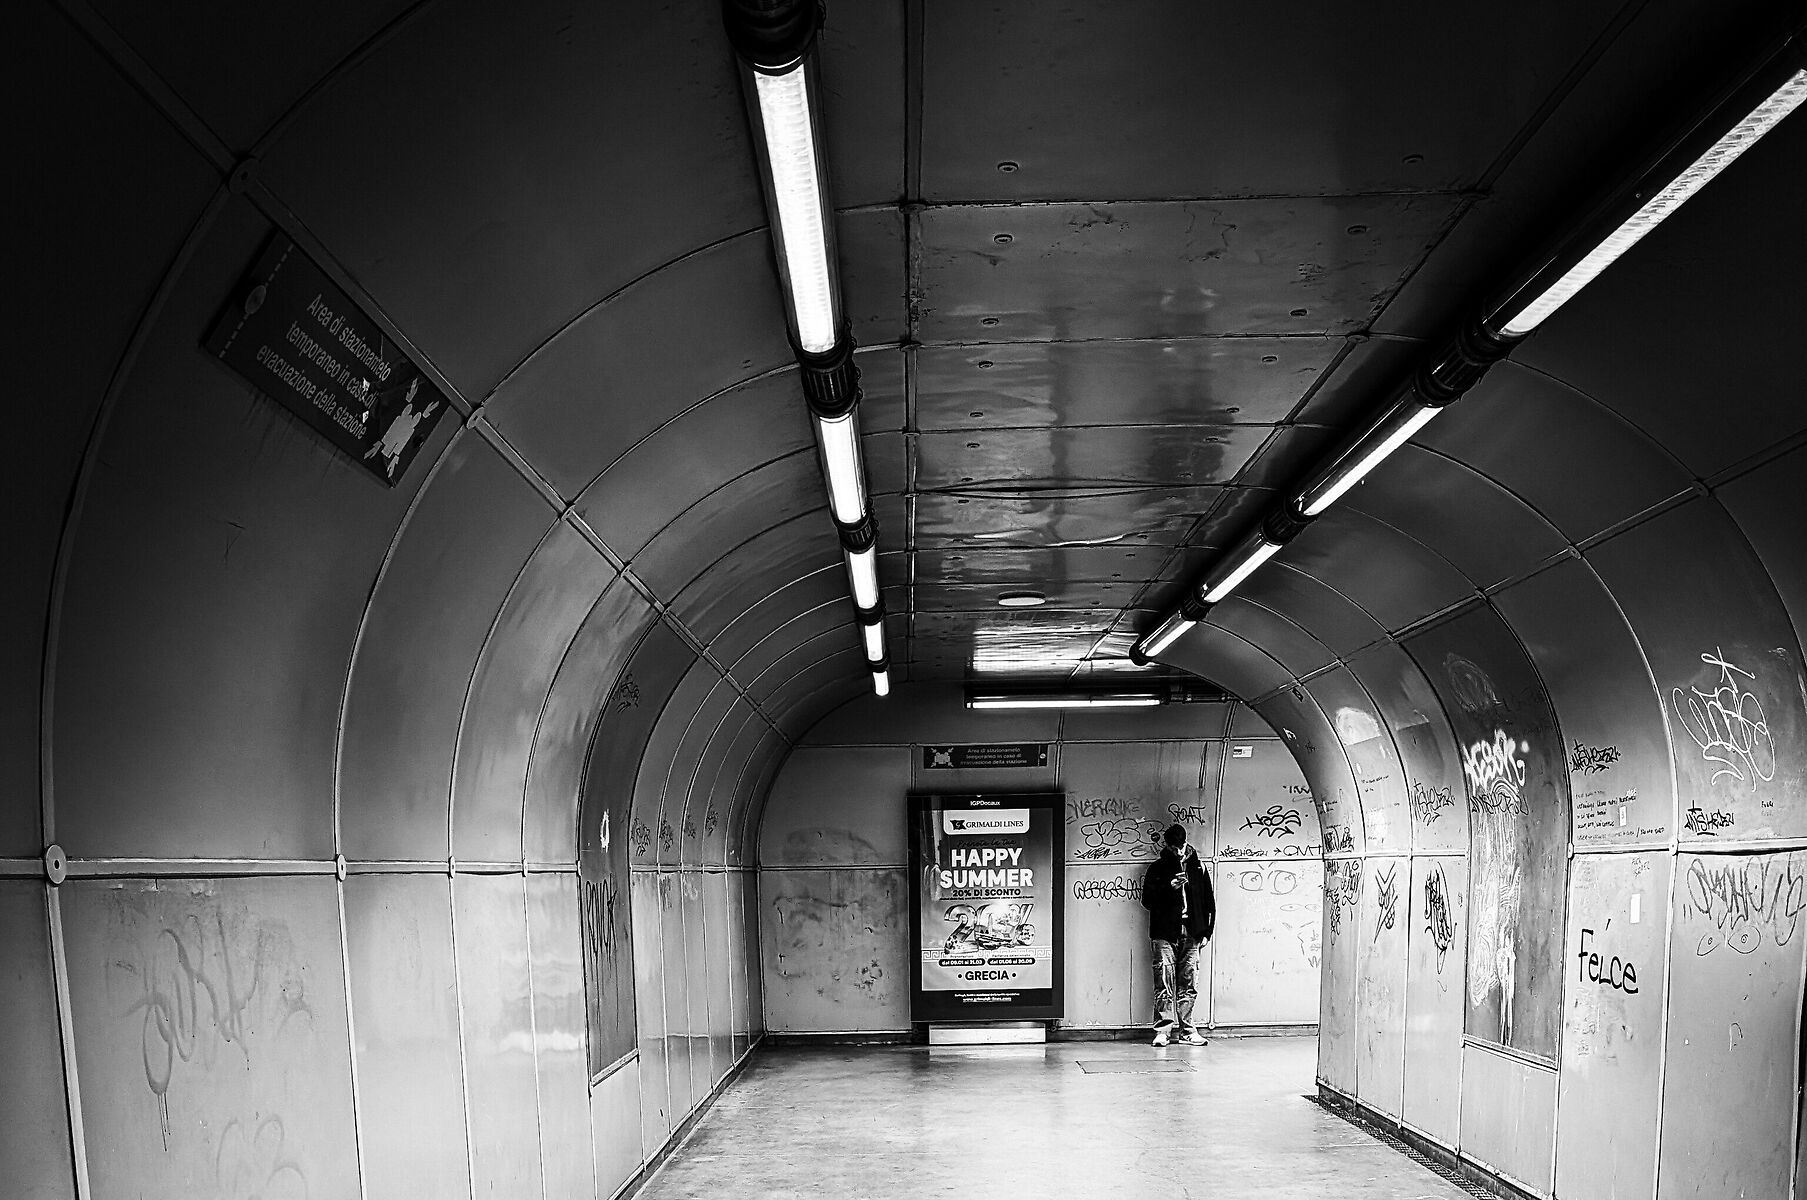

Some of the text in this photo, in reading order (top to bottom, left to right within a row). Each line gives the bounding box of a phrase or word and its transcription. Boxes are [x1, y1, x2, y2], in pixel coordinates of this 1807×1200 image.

[306, 293, 331, 328] Area
[329, 315, 347, 337] di
[284, 320, 342, 378] temporaneo
[337, 364, 351, 389] in
[363, 391, 378, 410] di
[256, 345, 367, 440] evacuazione della stazione
[965, 821, 1002, 829] GRIMALDI
[1003, 820, 1024, 828] LINES
[951, 847, 1023, 868] HAPPY
[940, 868, 1034, 889] SUMMER
[952, 889, 972, 897] 20%
[984, 888, 1021, 896] SCONTO
[965, 970, 1010, 981] GRECIA
